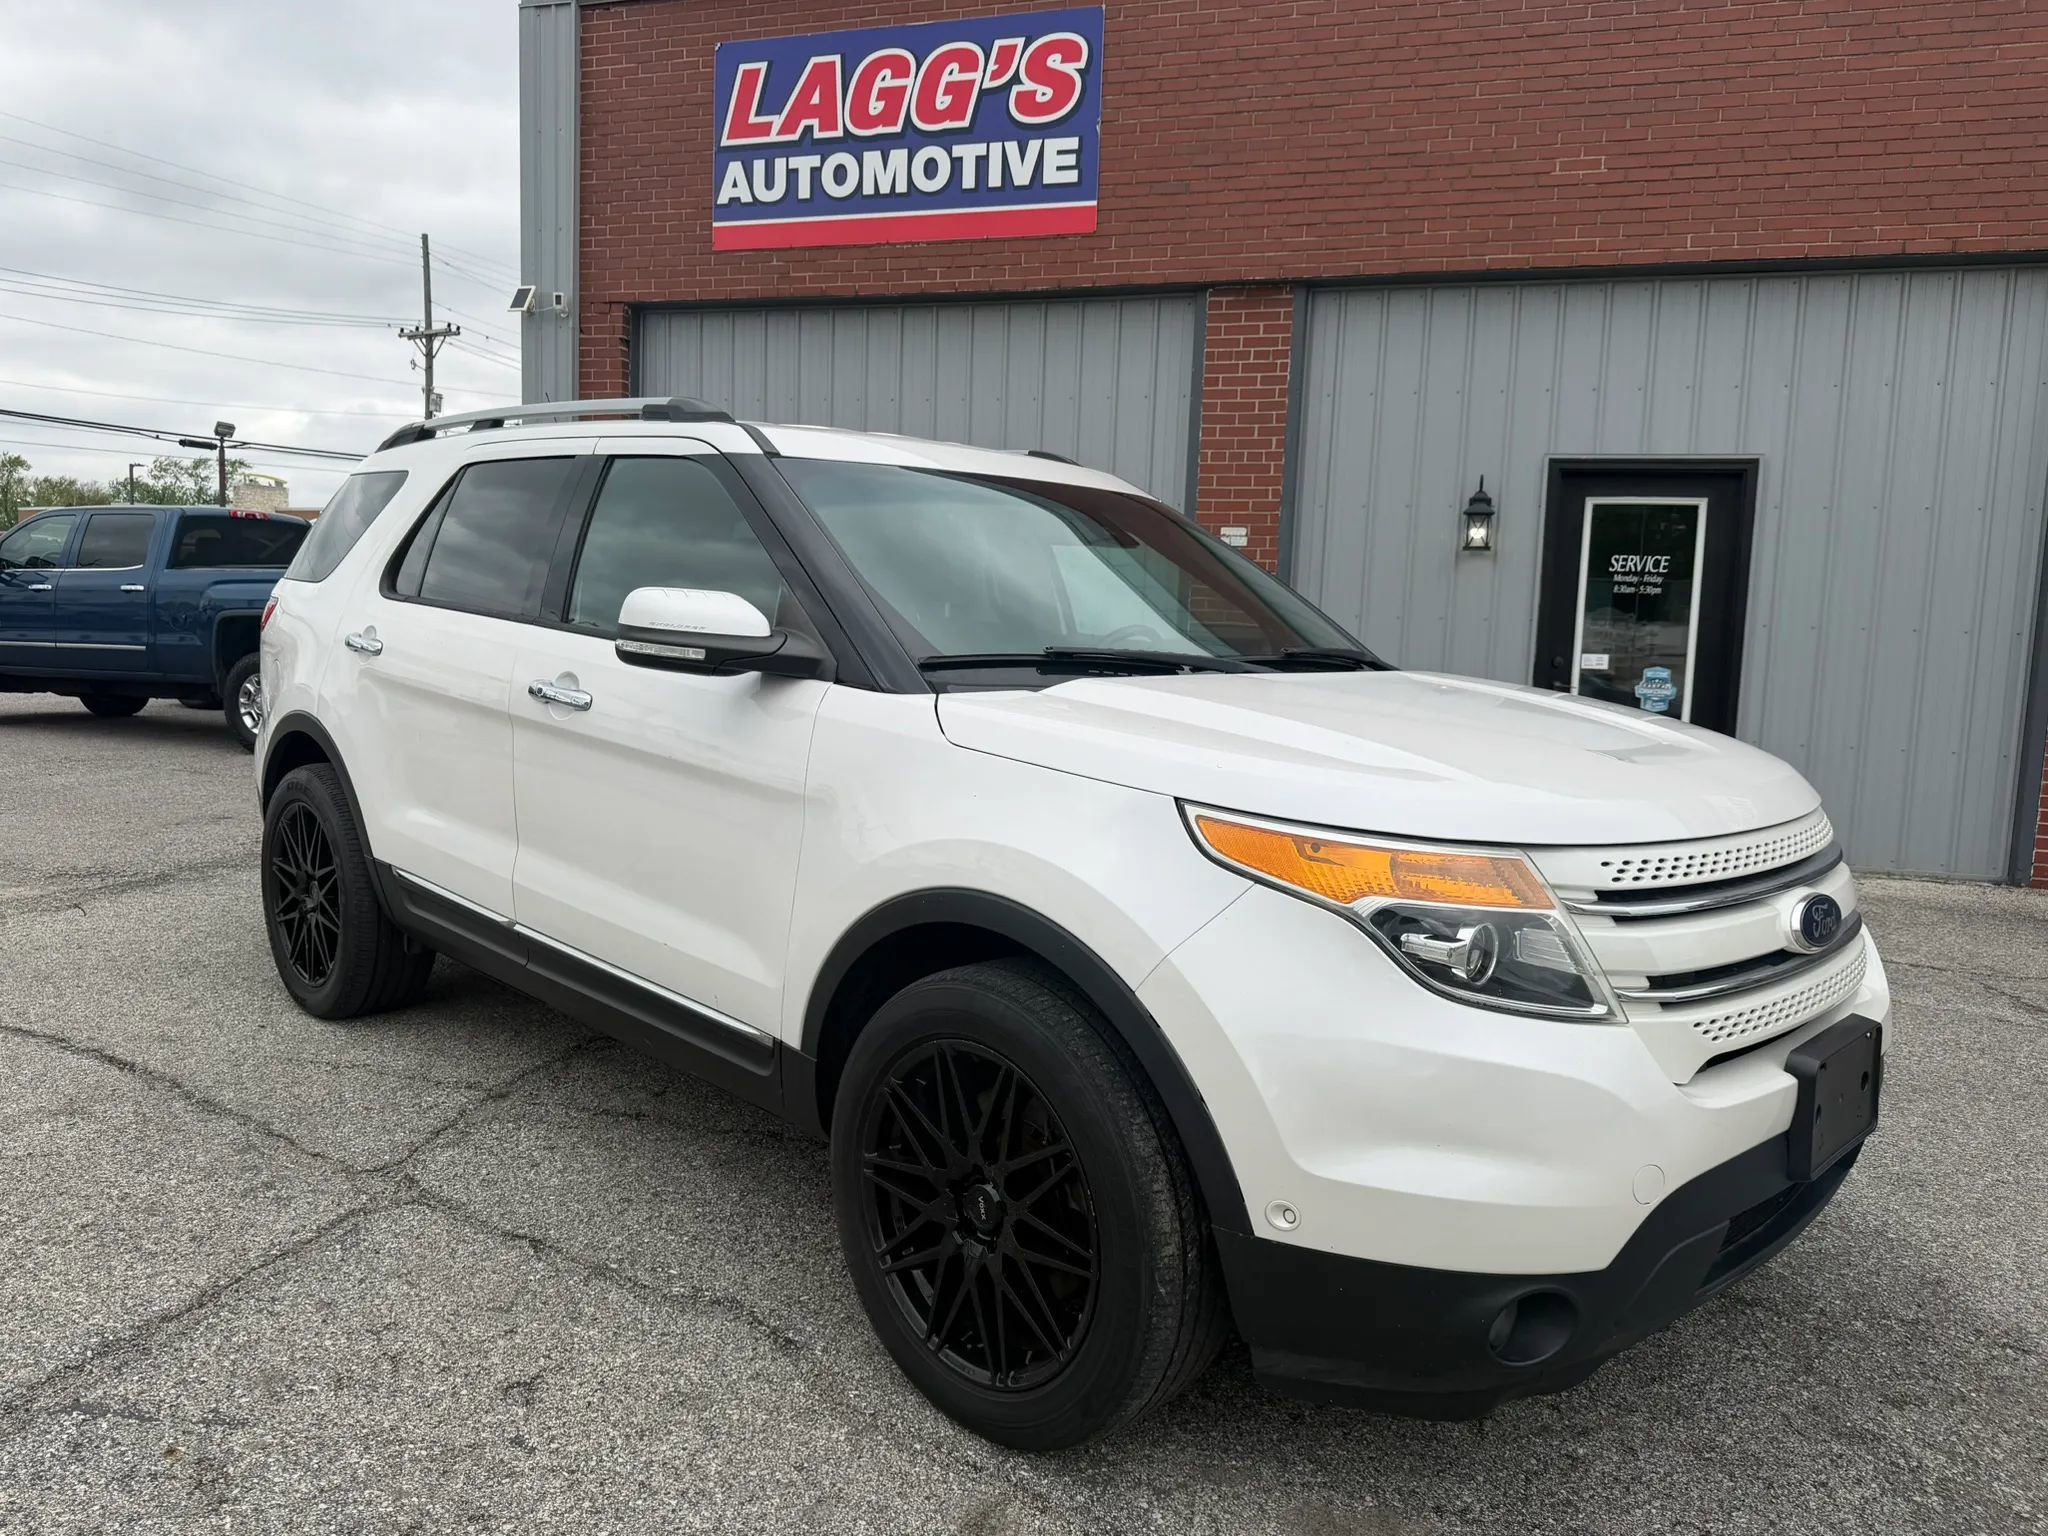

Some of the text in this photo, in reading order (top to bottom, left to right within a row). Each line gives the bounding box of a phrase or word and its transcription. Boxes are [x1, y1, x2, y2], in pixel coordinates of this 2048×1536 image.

[720, 31, 1090, 147] LAGG'S
[716, 136, 1080, 205] AUTOMOTIVE
[1609, 554, 1670, 572] SERVICE
[1613, 574, 1639, 584] Monday
[1643, 574, 1664, 585] Friday
[1811, 903, 1836, 938] Ford
[978, 1196, 986, 1220] VOXX
